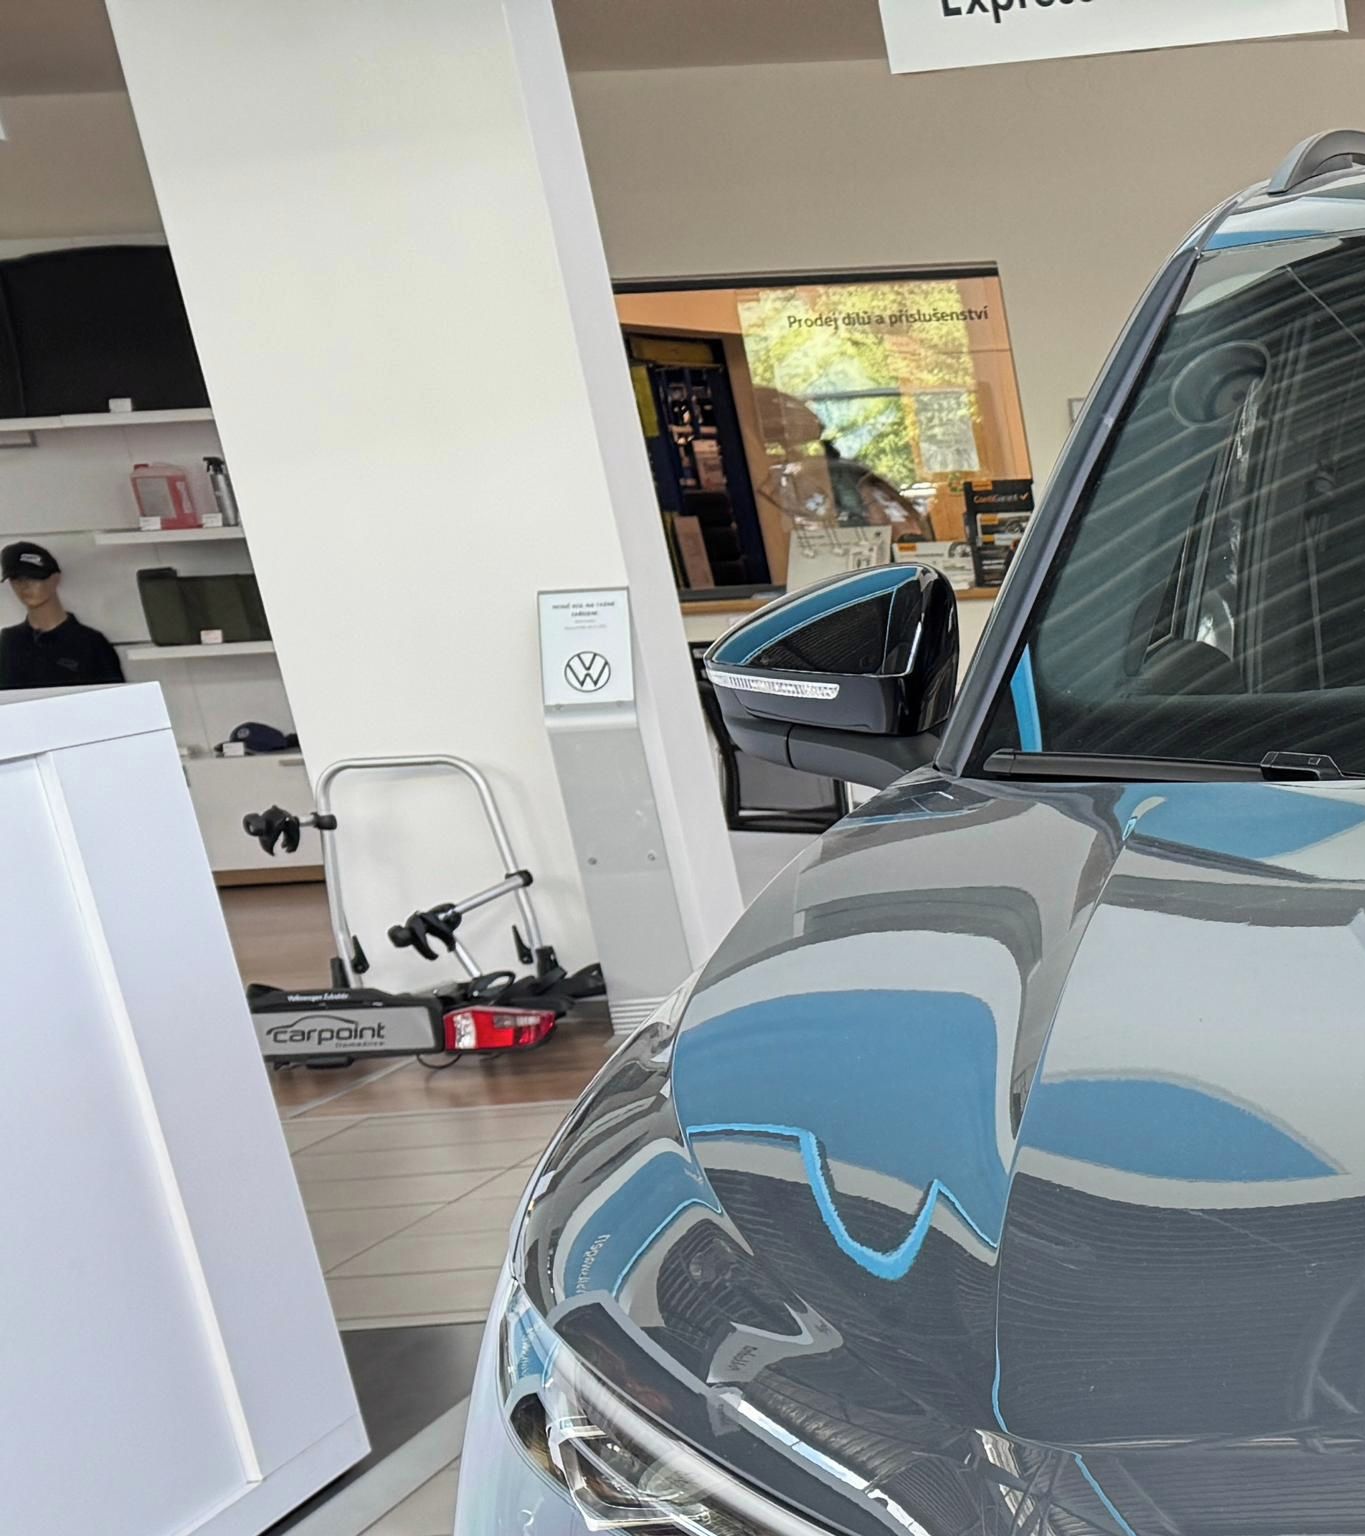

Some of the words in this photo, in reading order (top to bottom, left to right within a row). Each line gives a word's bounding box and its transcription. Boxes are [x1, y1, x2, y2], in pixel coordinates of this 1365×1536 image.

[786, 311, 838, 331] Prodej
[842, 310, 872, 327] dílů
[876, 315, 886, 326] a
[888, 304, 990, 328] příslušenství
[273, 1021, 386, 1046] carpoint
